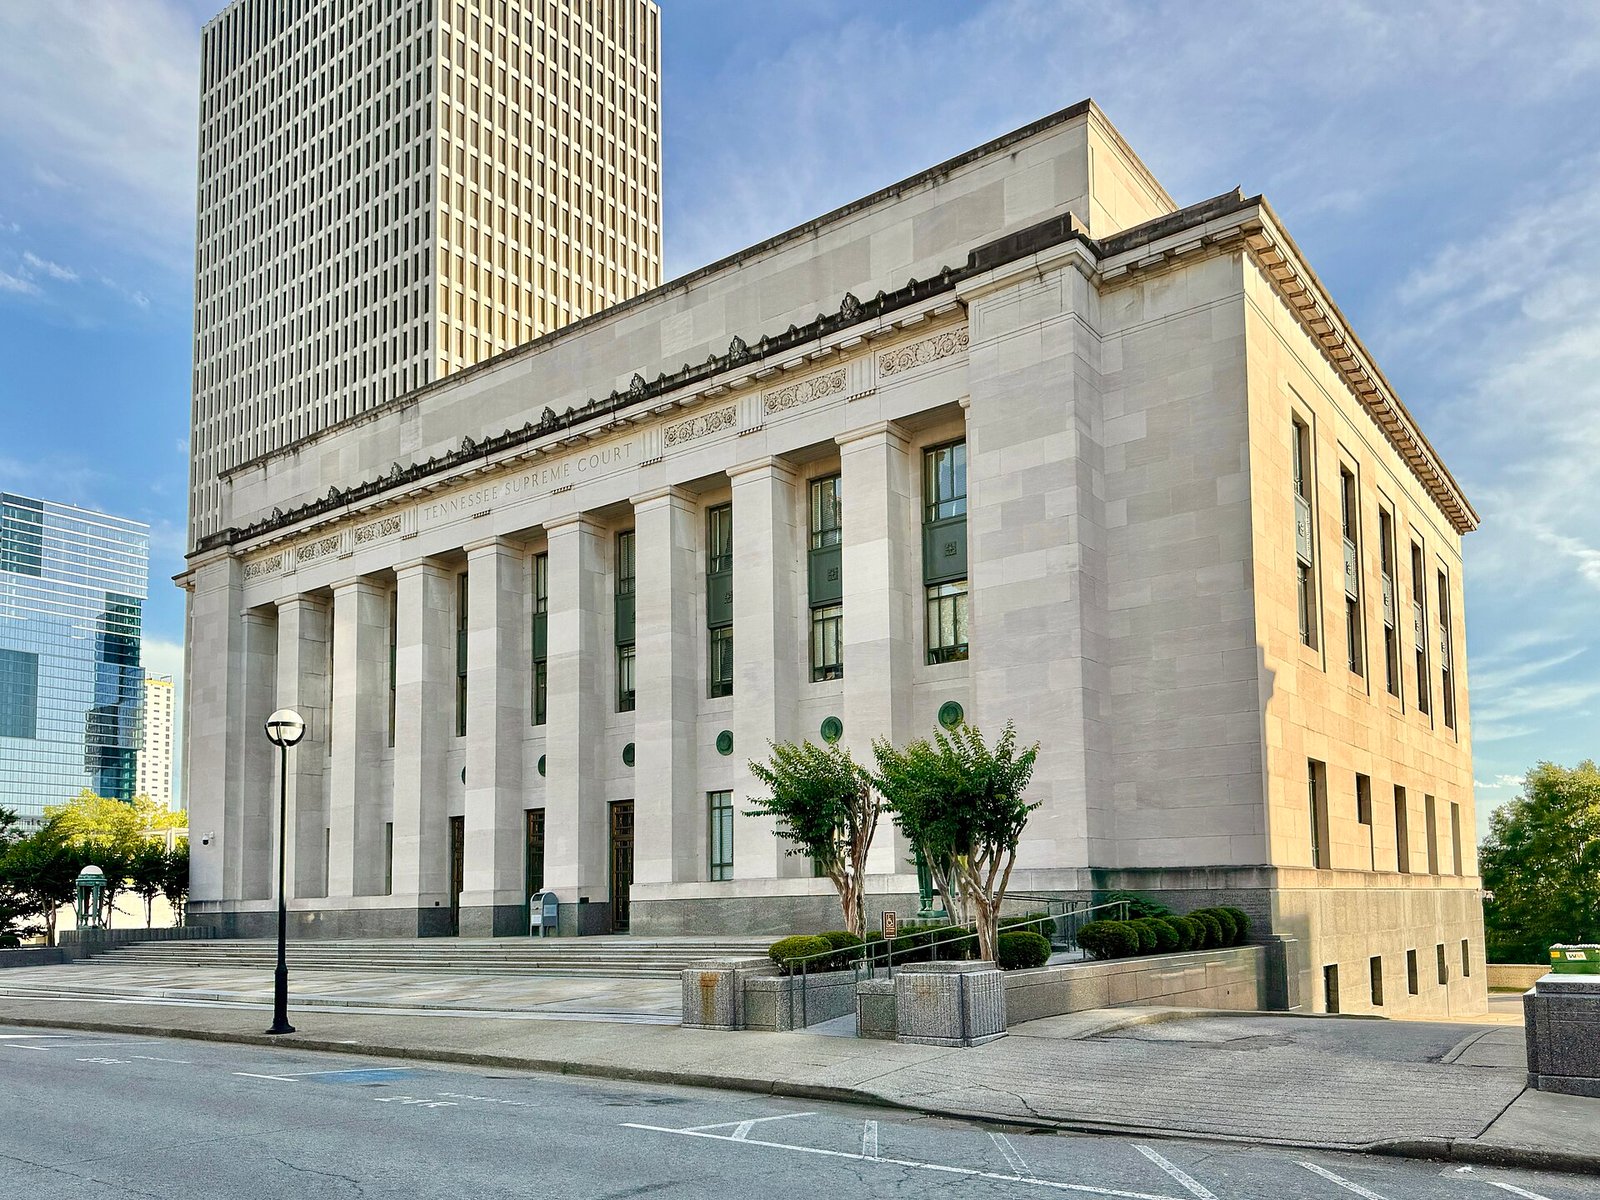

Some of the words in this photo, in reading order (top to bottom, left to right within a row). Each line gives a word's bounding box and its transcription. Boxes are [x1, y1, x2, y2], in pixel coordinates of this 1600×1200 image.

[424, 488, 498, 520] TENNESSEE
[505, 463, 570, 495] SUPREME
[577, 442, 633, 472] COURT
